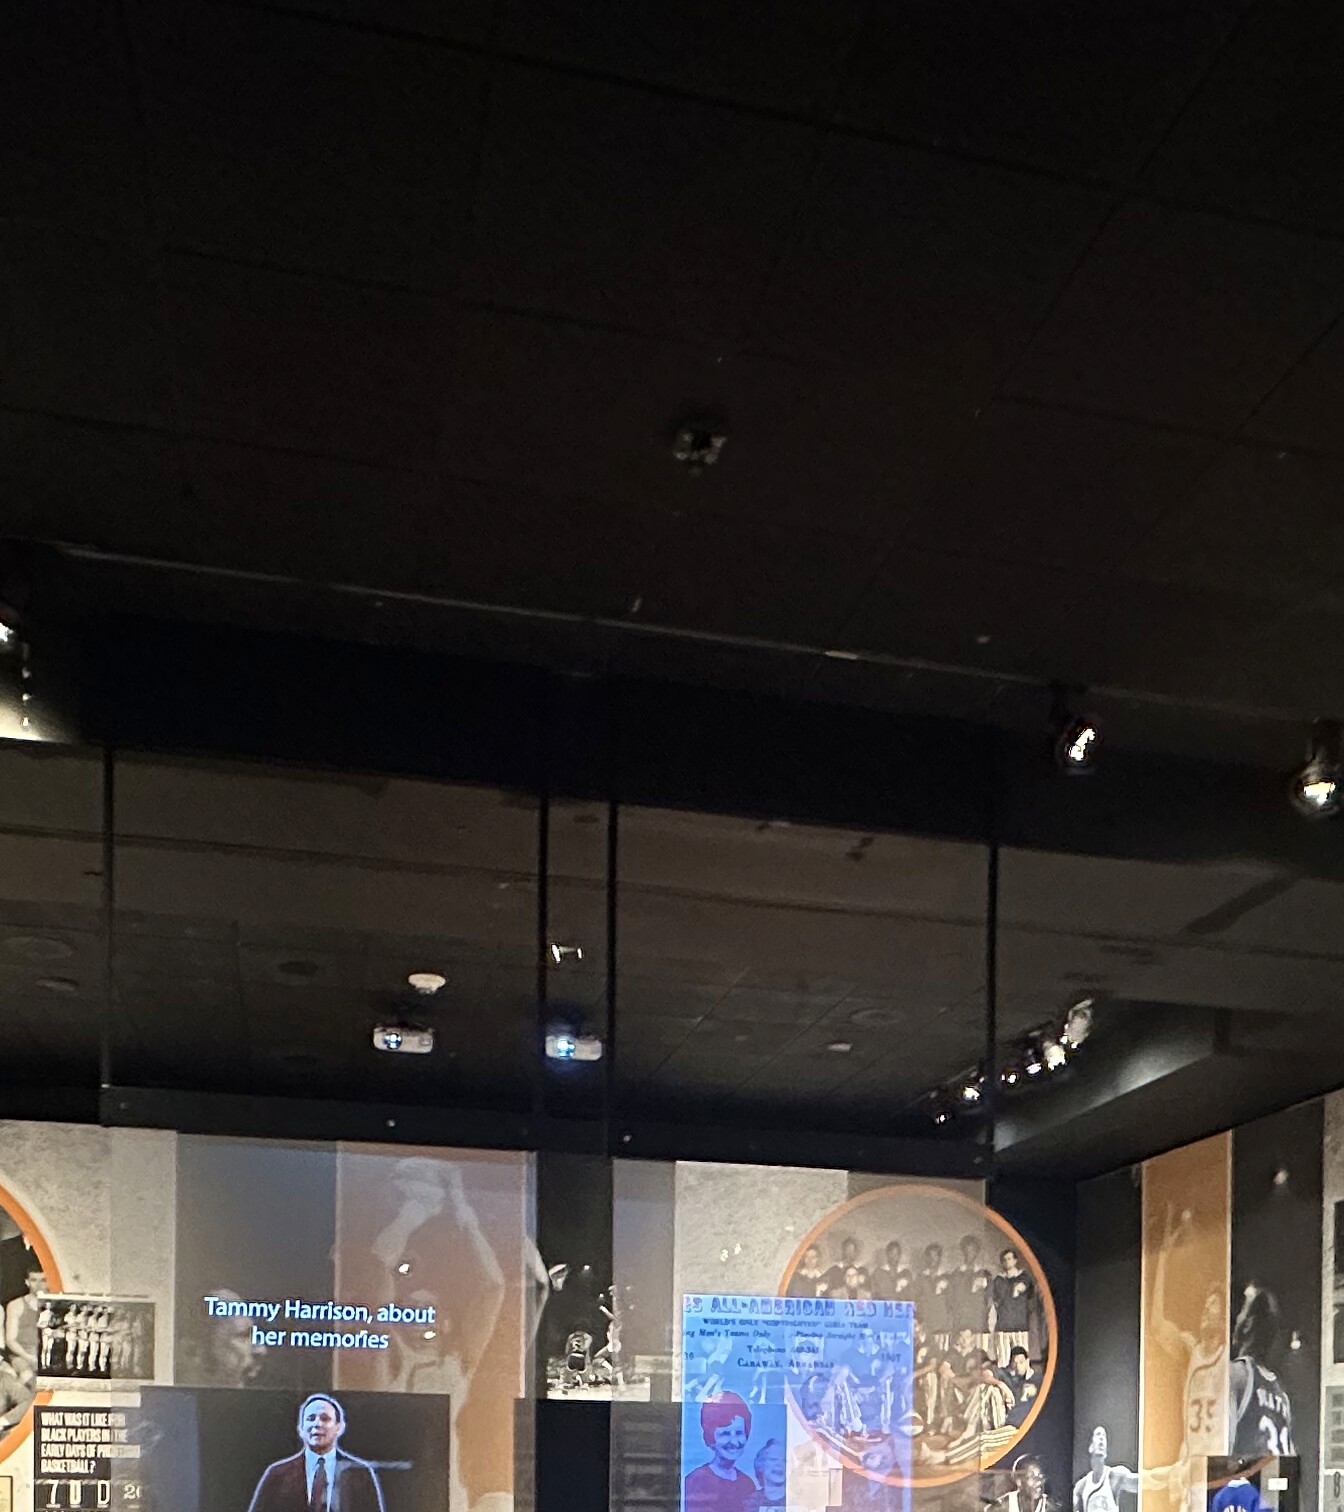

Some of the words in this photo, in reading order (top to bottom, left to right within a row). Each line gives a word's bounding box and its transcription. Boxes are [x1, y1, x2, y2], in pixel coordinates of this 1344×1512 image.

[204, 1297, 281, 1321] Tammy
[285, 1300, 373, 1324] Harrison,
[377, 1303, 436, 1323] about
[251, 1326, 286, 1346] her
[290, 1331, 389, 1348] memories
[41, 1412, 64, 1426] WHAT
[64, 1412, 82, 1426] WAS
[41, 1428, 67, 1442] BLACK
[67, 1428, 101, 1442] PLAYERS
[41, 1443, 64, 1457] EARLY
